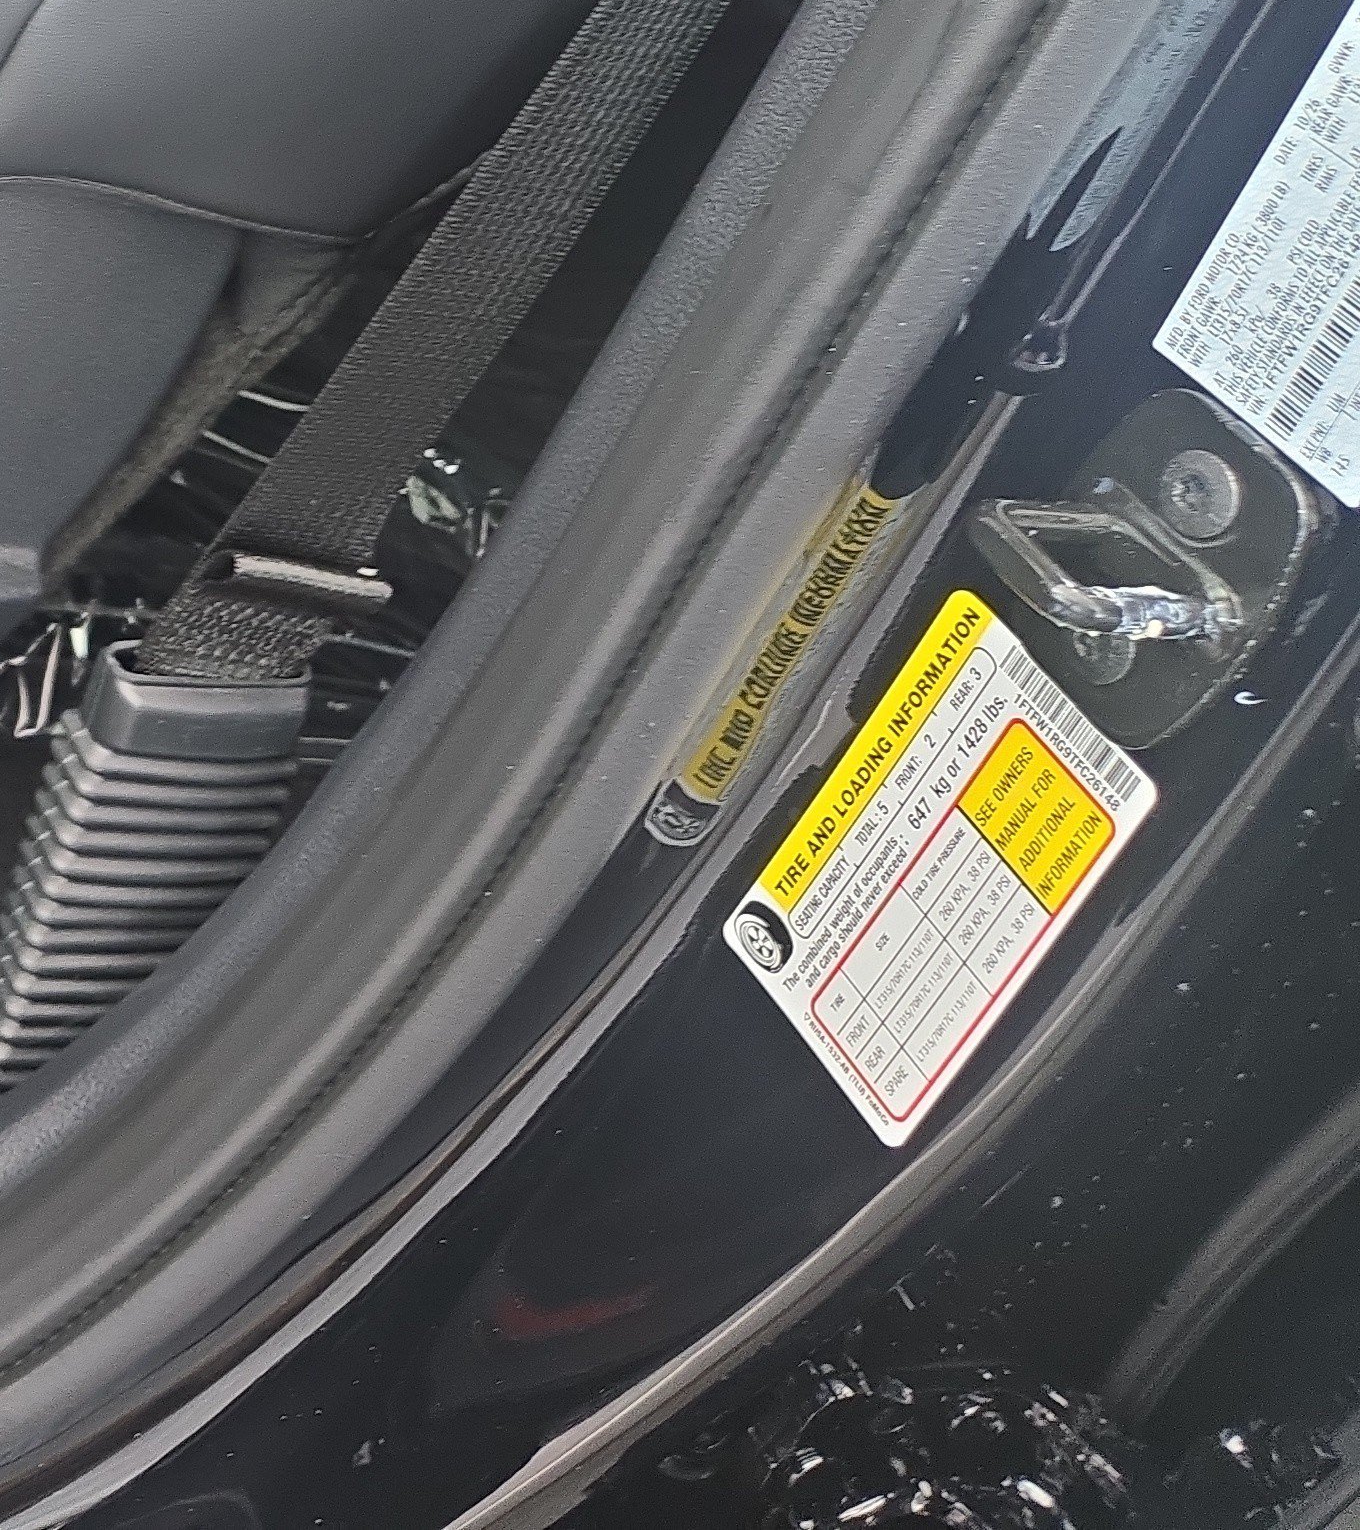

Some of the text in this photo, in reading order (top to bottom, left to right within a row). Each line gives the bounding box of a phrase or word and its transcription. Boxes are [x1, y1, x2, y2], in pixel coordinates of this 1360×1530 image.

[1299, 150, 1326, 186] TIRES
[1308, 104, 1333, 137] REAR
[1321, 113, 1347, 147] WITH
[1163, 227, 1243, 350] MFD. BY FORD MOTOR CO.
[1175, 324, 1202, 359] FRONT
[1241, 230, 1258, 250] KG
[1187, 339, 1211, 369] WITH
[1211, 370, 1227, 387] AT
[1224, 342, 1244, 367] 260
[1265, 280, 1282, 300] 38
[1296, 216, 1321, 248] COLD
[1222, 370, 1245, 398] THIS
[1235, 332, 1268, 375] VEHICLE
[1259, 279, 1301, 337] CONFORMS
[1292, 263, 1310, 284] TO
[1301, 245, 1321, 269] ALL
[1312, 188, 1356, 251] APPLICABLE
[1234, 370, 1263, 407] SAFETY
[1255, 313, 1298, 374] STANDARDS
[1290, 299, 1306, 318] IN
[1298, 266, 1327, 304] EFFECT
[1318, 248, 1337, 271] ON
[1329, 229, 1349, 254] THE
[774, 603, 983, 900] TIRE AND LOADING INFORMATION
[793, 891, 824, 933] SEATING
[816, 852, 851, 900] CAPACITY
[875, 798, 890, 816] 5
[893, 751, 923, 791] FRONT:
[922, 731, 937, 749] 2
[948, 676, 975, 713] REAR:
[968, 664, 983, 682] 3
[905, 687, 1009, 832] 647 kg or 1428 lbs.
[972, 743, 1035, 828] SEE OWNERS
[993, 766, 1057, 852] MANUAL FOR
[1015, 792, 1077, 872] ADDITIONAL
[1033, 808, 1105, 901] INFORMATION
[781, 832, 901, 993] The combined weight of occupants
[803, 844, 908, 989] and cargo should never exceed
[829, 825, 966, 1013] TIRE SIZE COLD TIRE PRESSURE
[844, 1013, 871, 1048] FRONT
[937, 899, 956, 923] 260
[965, 863, 982, 884] 38
[975, 849, 991, 870] PSI
[863, 1043, 886, 1073] REAR
[957, 923, 976, 947] 260
[985, 887, 1002, 908] 38
[995, 873, 1012, 894] PSI
[882, 1063, 909, 1098] SPARE
[980, 950, 999, 974] 260
[1008, 914, 1025, 935] 38
[1018, 900, 1035, 921] PSI
